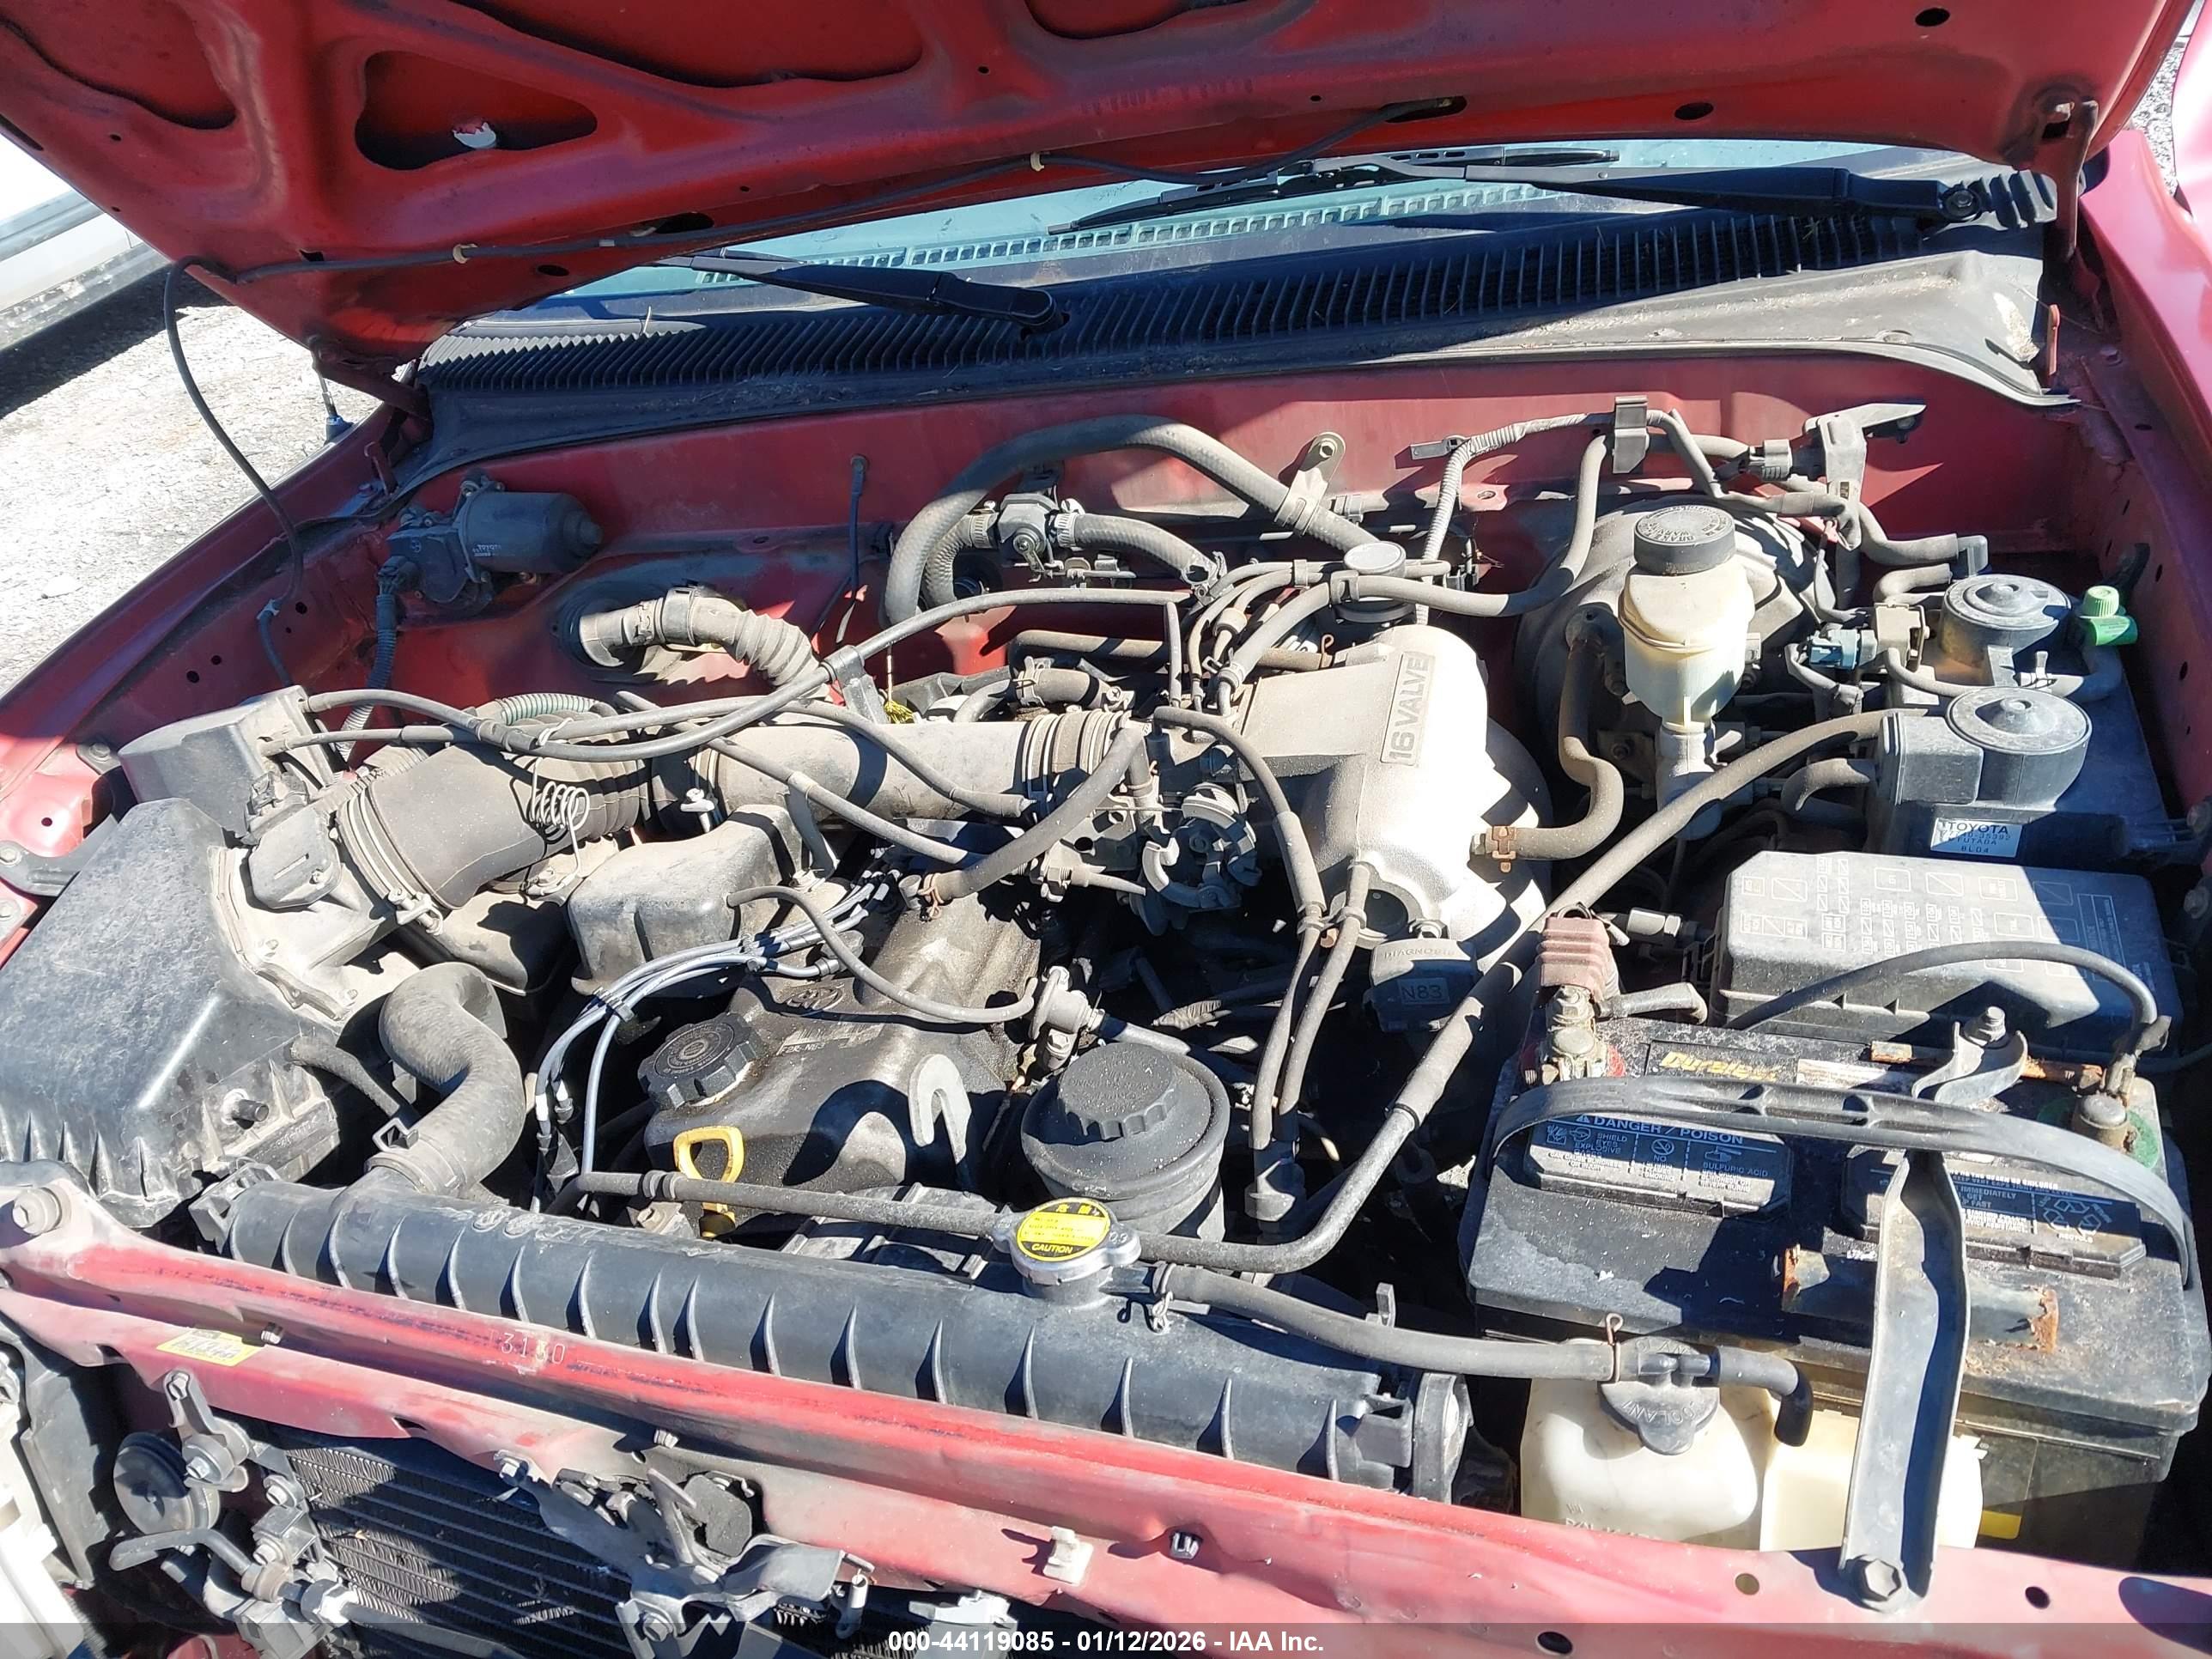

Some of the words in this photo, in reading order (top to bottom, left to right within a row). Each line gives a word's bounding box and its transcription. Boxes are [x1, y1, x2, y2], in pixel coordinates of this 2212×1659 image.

[1395, 657, 1431, 726] VALVE
[1389, 732, 1415, 759] 16
[1949, 822, 2008, 835] TOYOTA
[1401, 985, 1443, 1000] N83
[1594, 1116, 1662, 1134] DANGER
[1680, 1127, 1744, 1145] POISON
[1597, 1133, 1628, 1143] SHIELD
[1703, 1162, 1745, 1174] SULFURIC
[1747, 1168, 1769, 1177] ACID
[1960, 1187, 2017, 1200] IMMEDIATELY
[1031, 1243, 1073, 1255] CAUTION
[1621, 1401, 1696, 1425] OOLANT
